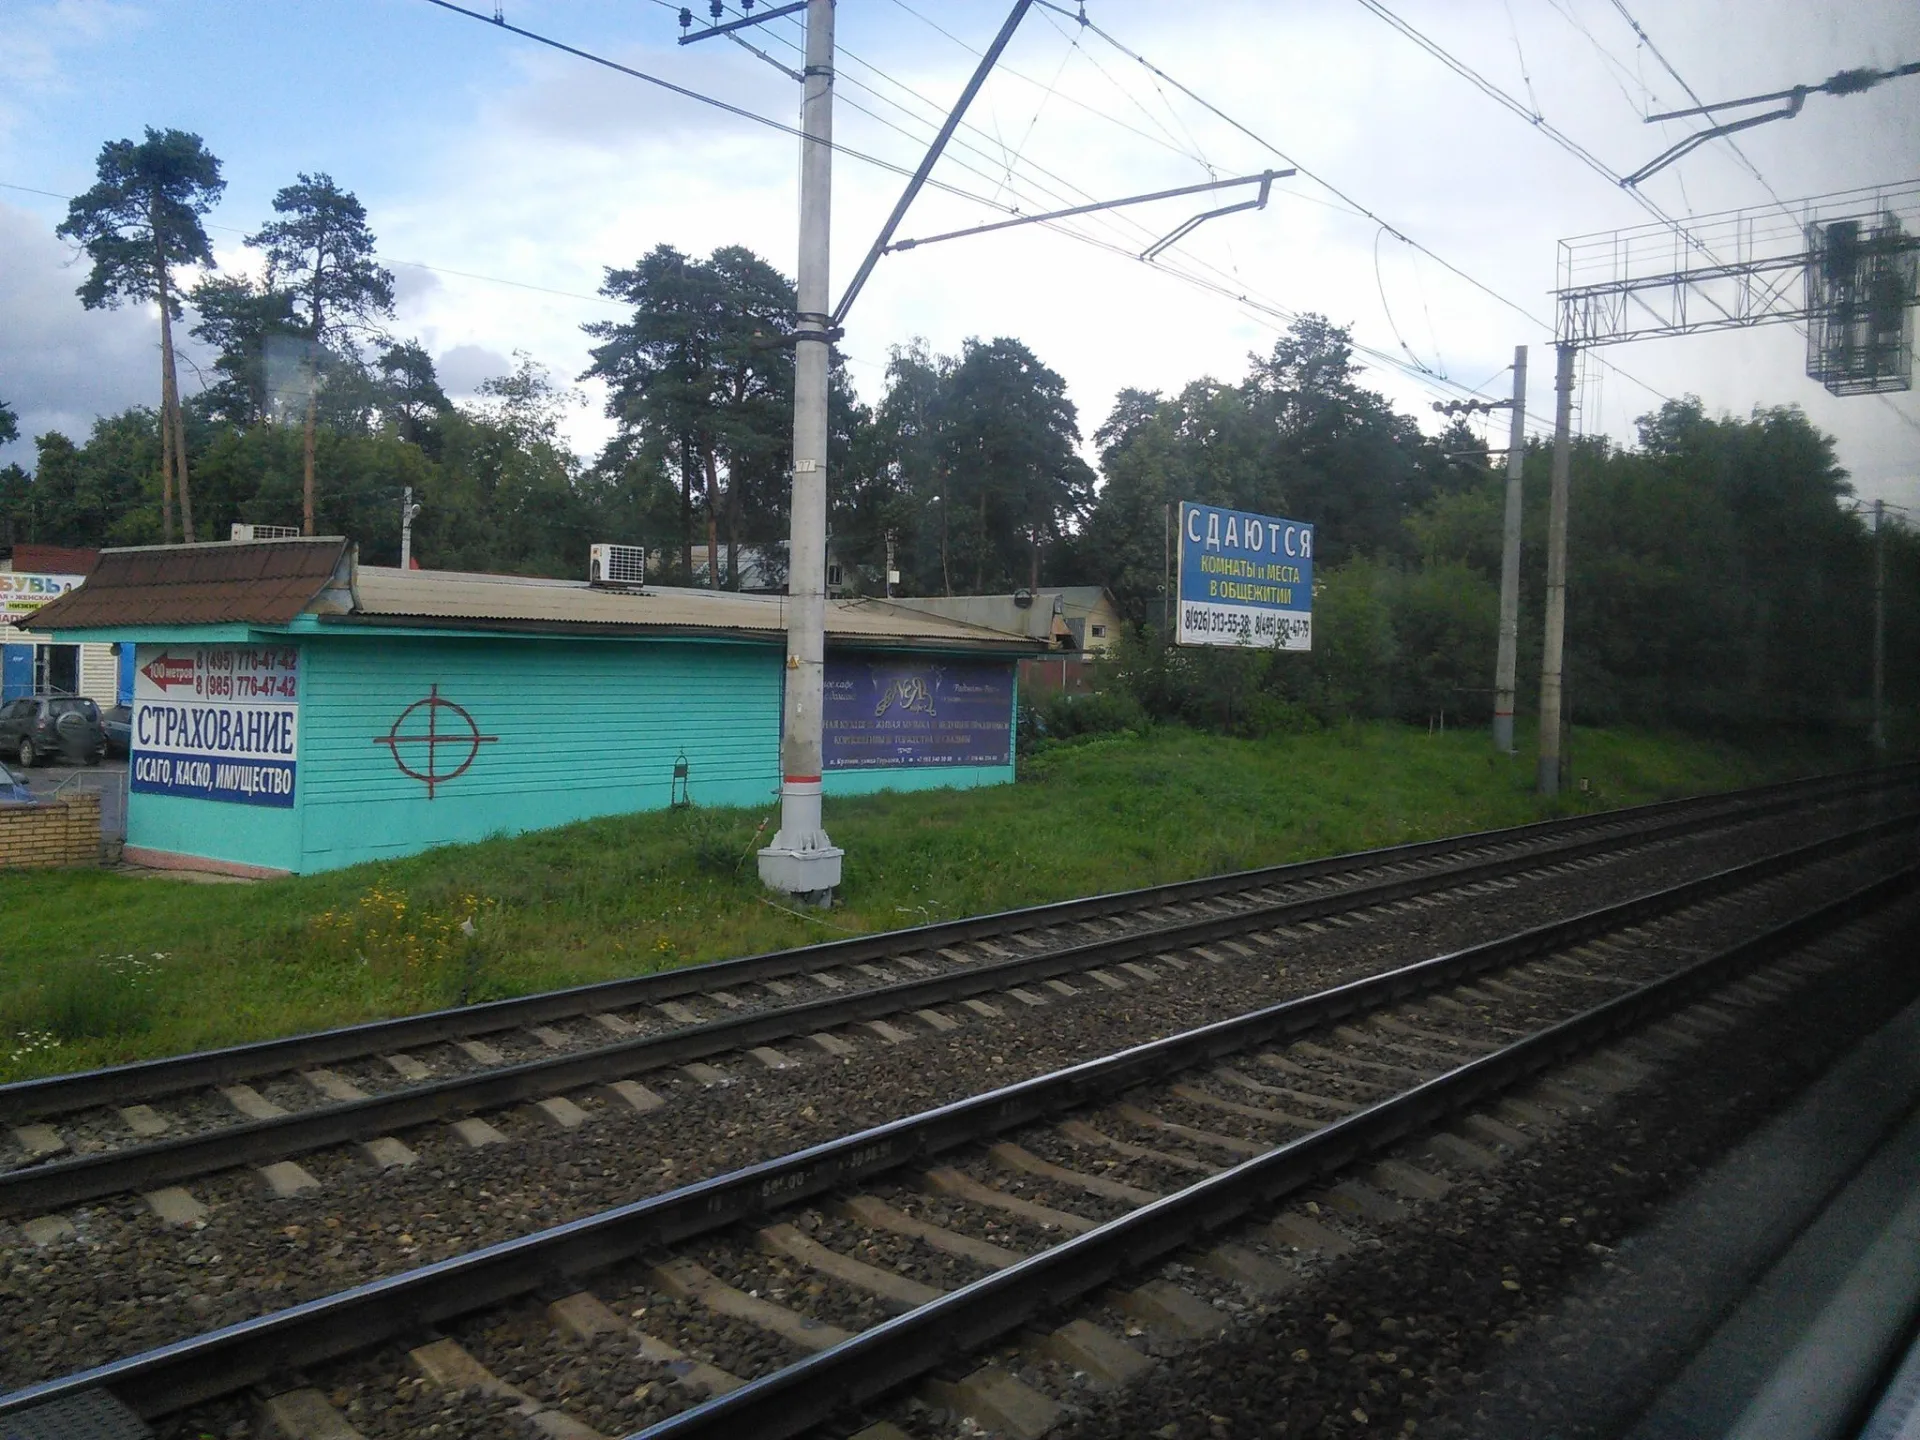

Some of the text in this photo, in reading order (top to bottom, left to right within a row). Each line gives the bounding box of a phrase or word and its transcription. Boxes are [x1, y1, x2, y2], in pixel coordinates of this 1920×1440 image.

[1187, 508, 1312, 558] СДАЮТСЯ
[1201, 554, 1300, 583] КОМНАТЫ и МЕСТА
[1210, 579, 1291, 604] В ОБЩЕЖИТИИ
[150, 663, 193, 682] 100 метров
[206, 674, 233, 700] (985)
[237, 675, 296, 697] 776-47-42
[138, 705, 294, 755] СТРАХОВАНИЕ
[136, 757, 291, 796] ОСАГО, КАСКО, ИМУЩЕСТВО
